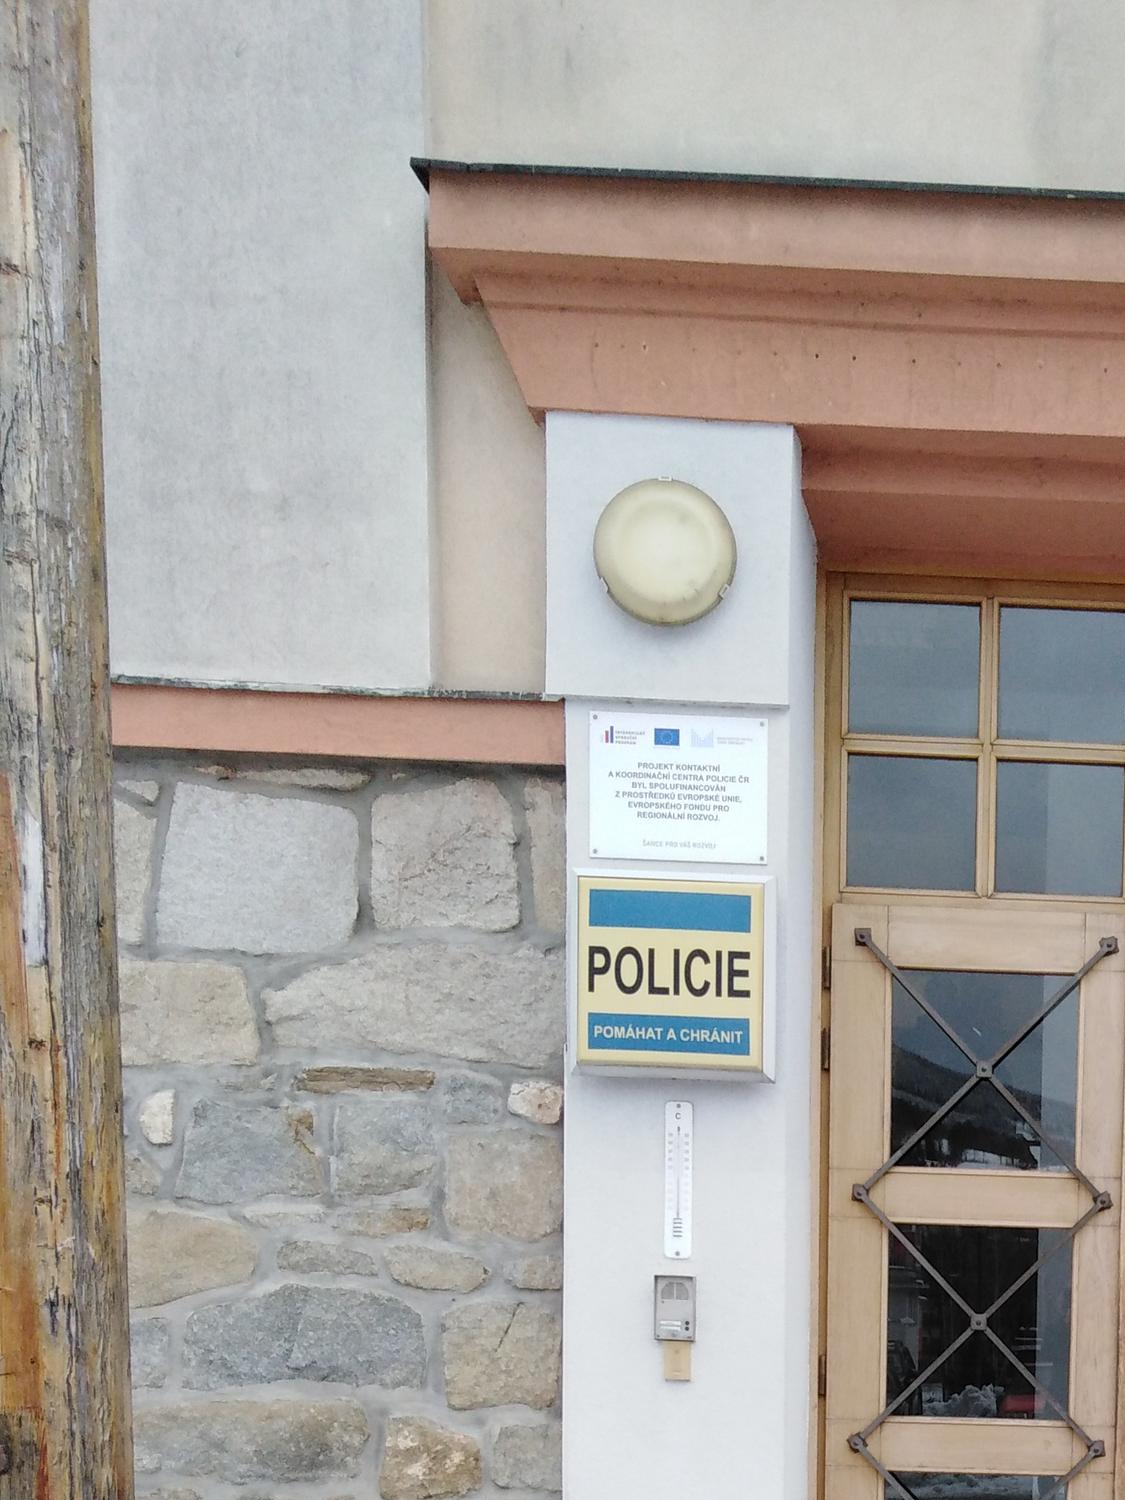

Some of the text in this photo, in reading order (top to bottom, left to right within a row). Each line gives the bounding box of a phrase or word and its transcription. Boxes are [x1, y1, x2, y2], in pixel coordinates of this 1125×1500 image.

[637, 762, 721, 772] PROJEKT KONTAKTNÍ
[615, 771, 670, 781] KOORDINAČNÍ
[672, 773, 704, 782] CENTRA
[706, 774, 736, 783] POLICIE
[738, 774, 750, 783] ČR
[649, 782, 726, 792] SPOLUFINANCOVÁN
[622, 791, 675, 801] PROSTŘEDKŮ
[677, 793, 720, 802] EVROPSKÉ
[627, 801, 730, 812] EVROPSKÉHO FONDU PRO
[636, 811, 686, 821] REGIONÁLNÍ
[588, 945, 751, 998] POLICIE
[594, 1024, 743, 1043] POMÁHAT A CHRÁNIT
